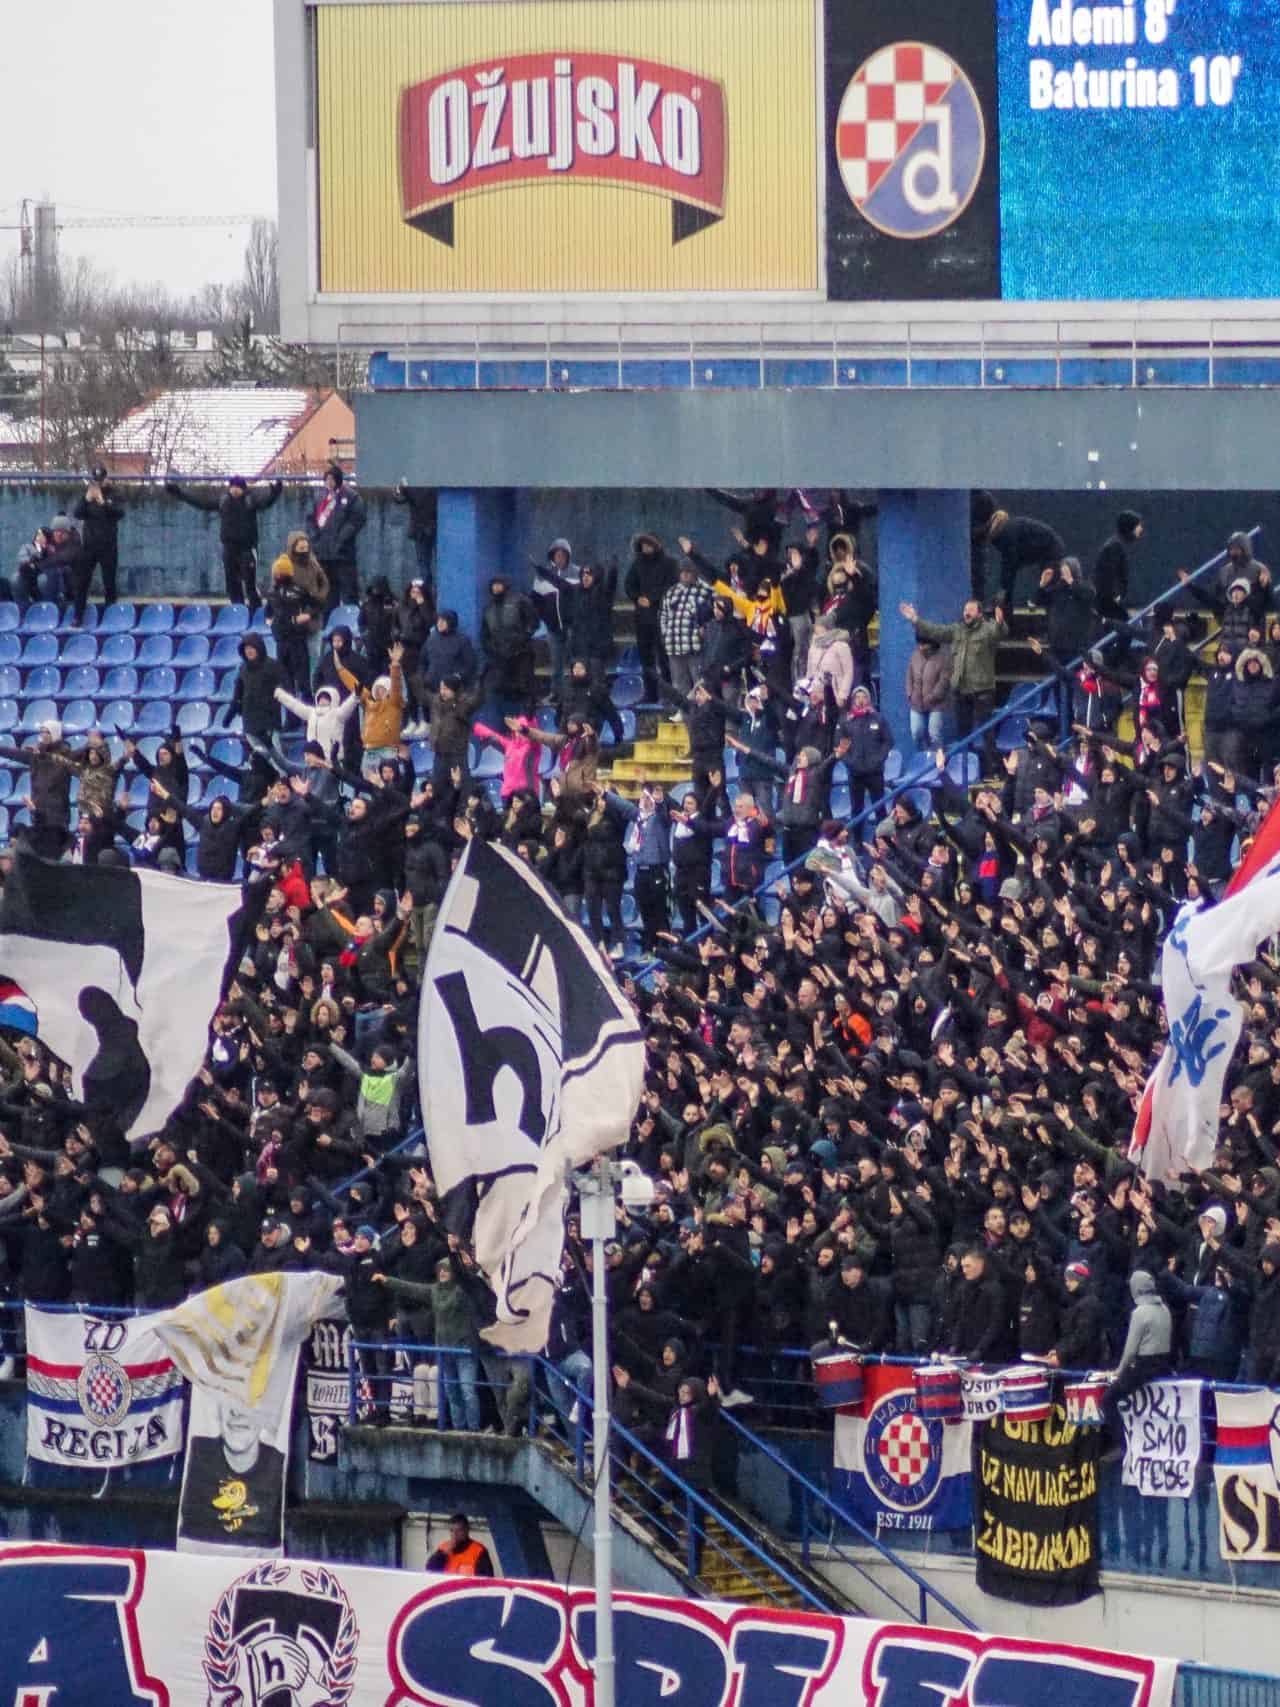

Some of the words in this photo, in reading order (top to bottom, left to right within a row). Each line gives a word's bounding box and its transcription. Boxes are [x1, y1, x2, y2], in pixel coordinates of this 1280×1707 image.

[1028, 0, 1136, 46] Ademi
[1029, 57, 1178, 109] Baturina
[427, 58, 702, 185] Ožujsko
[42, 1415, 168, 1460] REGIJA
